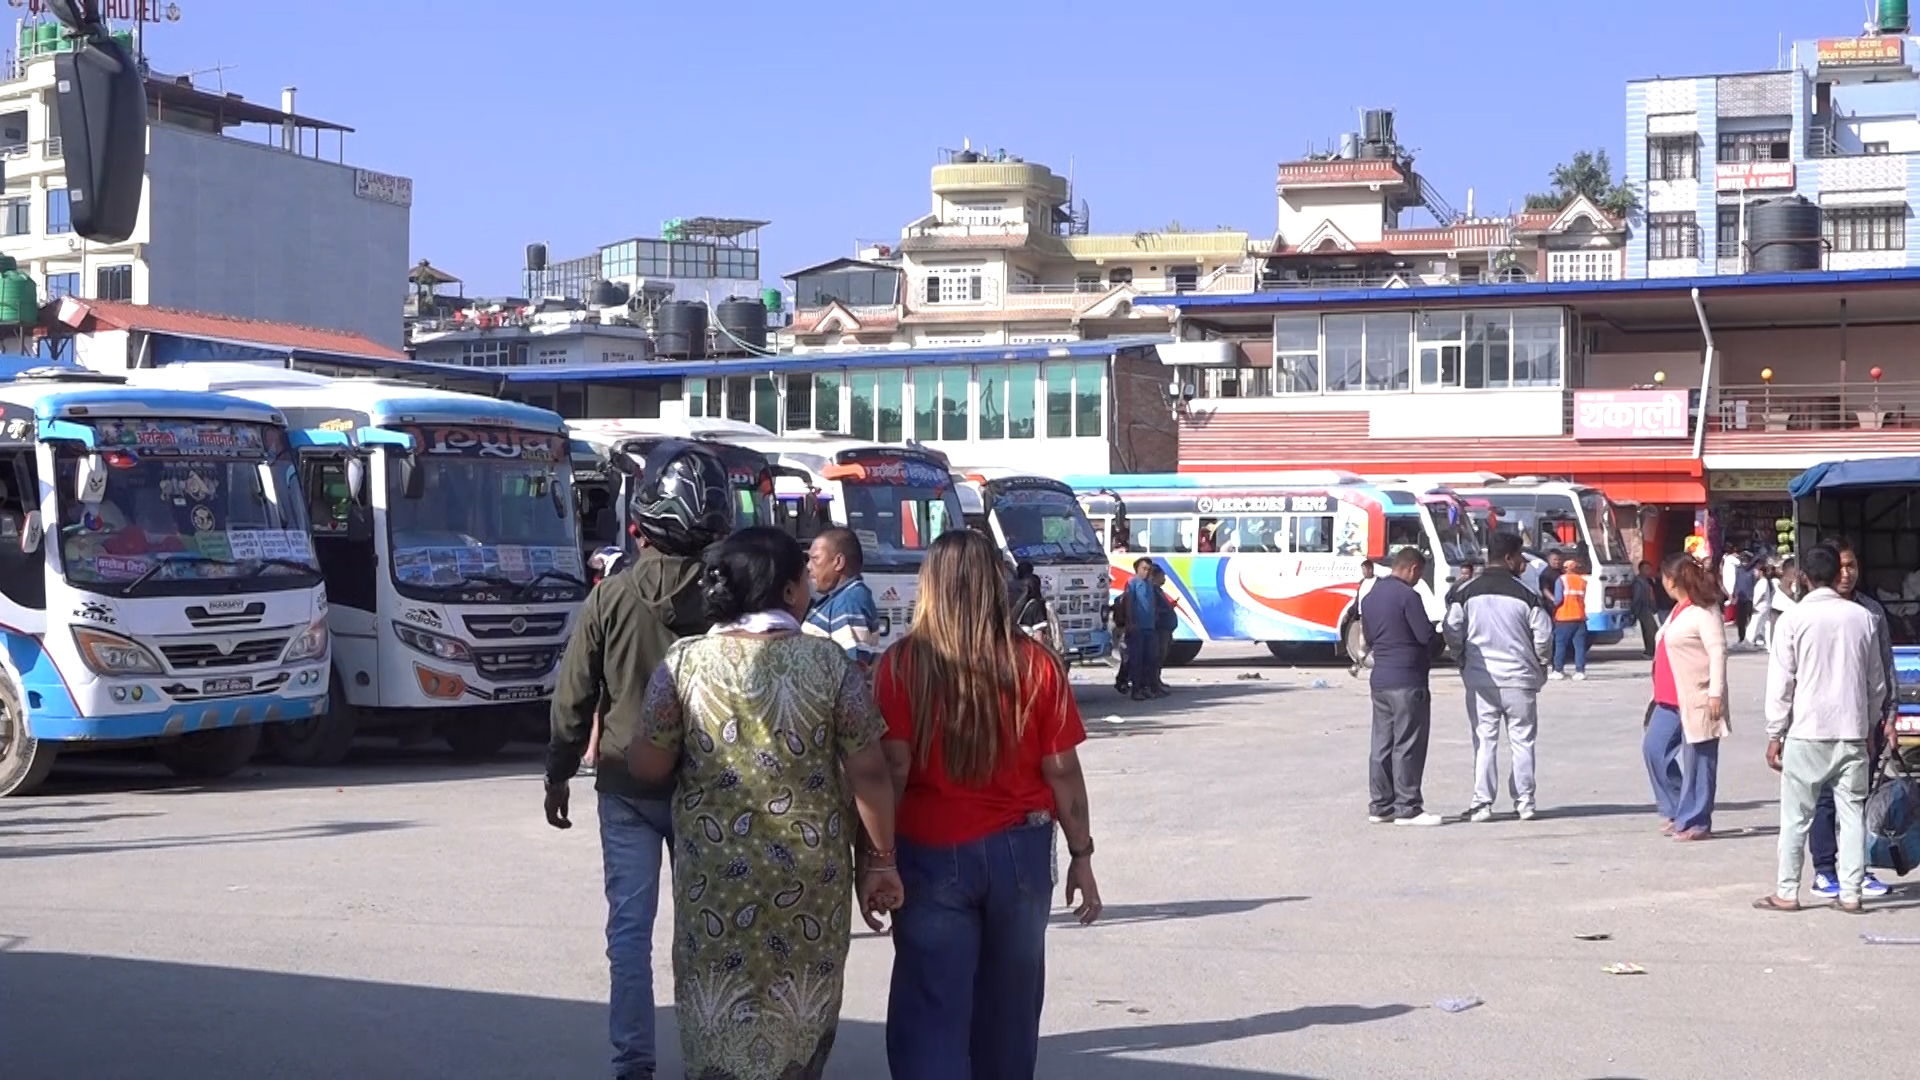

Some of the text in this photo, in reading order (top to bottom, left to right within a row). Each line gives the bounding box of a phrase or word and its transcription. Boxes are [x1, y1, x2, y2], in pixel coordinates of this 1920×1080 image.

[1580, 394, 1684, 429] थकाली
[1212, 496, 1328, 512] MERCEDES BENZ
[405, 612, 443, 629] adidas
